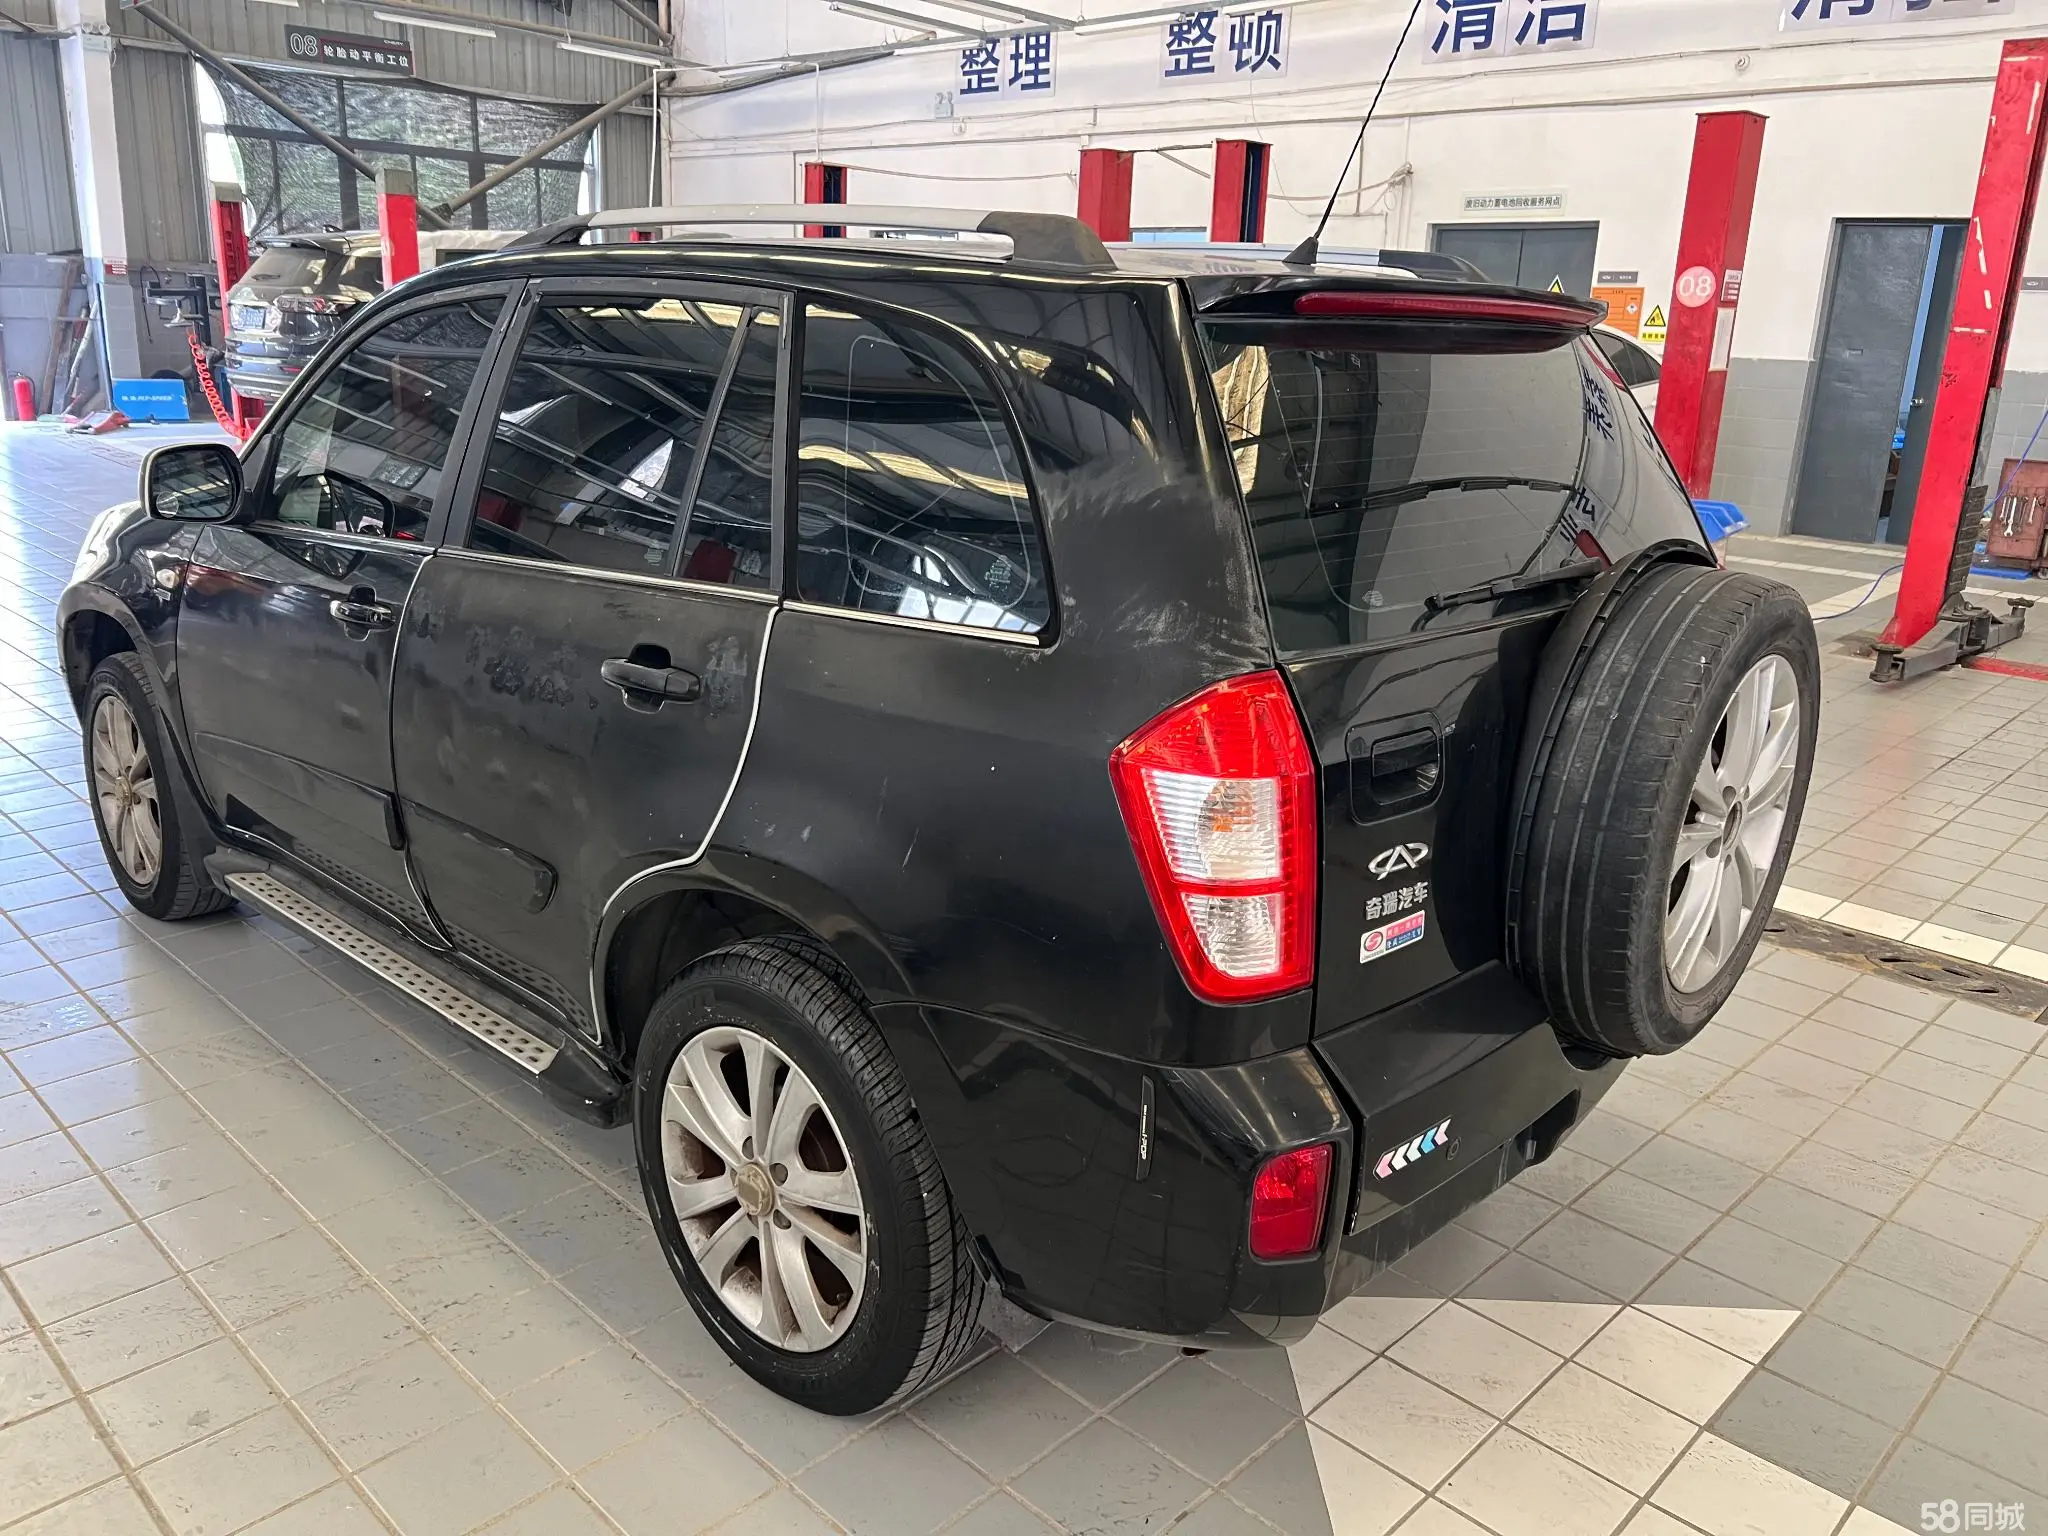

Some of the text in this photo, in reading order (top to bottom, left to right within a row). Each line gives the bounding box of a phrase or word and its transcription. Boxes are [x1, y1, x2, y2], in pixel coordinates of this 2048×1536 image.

[290, 33, 318, 57] 08
[323, 45, 409, 67] 轮胎动平衡工位
[1164, 10, 1283, 77] 整顿
[959, 31, 1050, 95] 整理
[1679, 275, 1712, 297] 08
[1365, 881, 1428, 920] 奇瑞汽车
